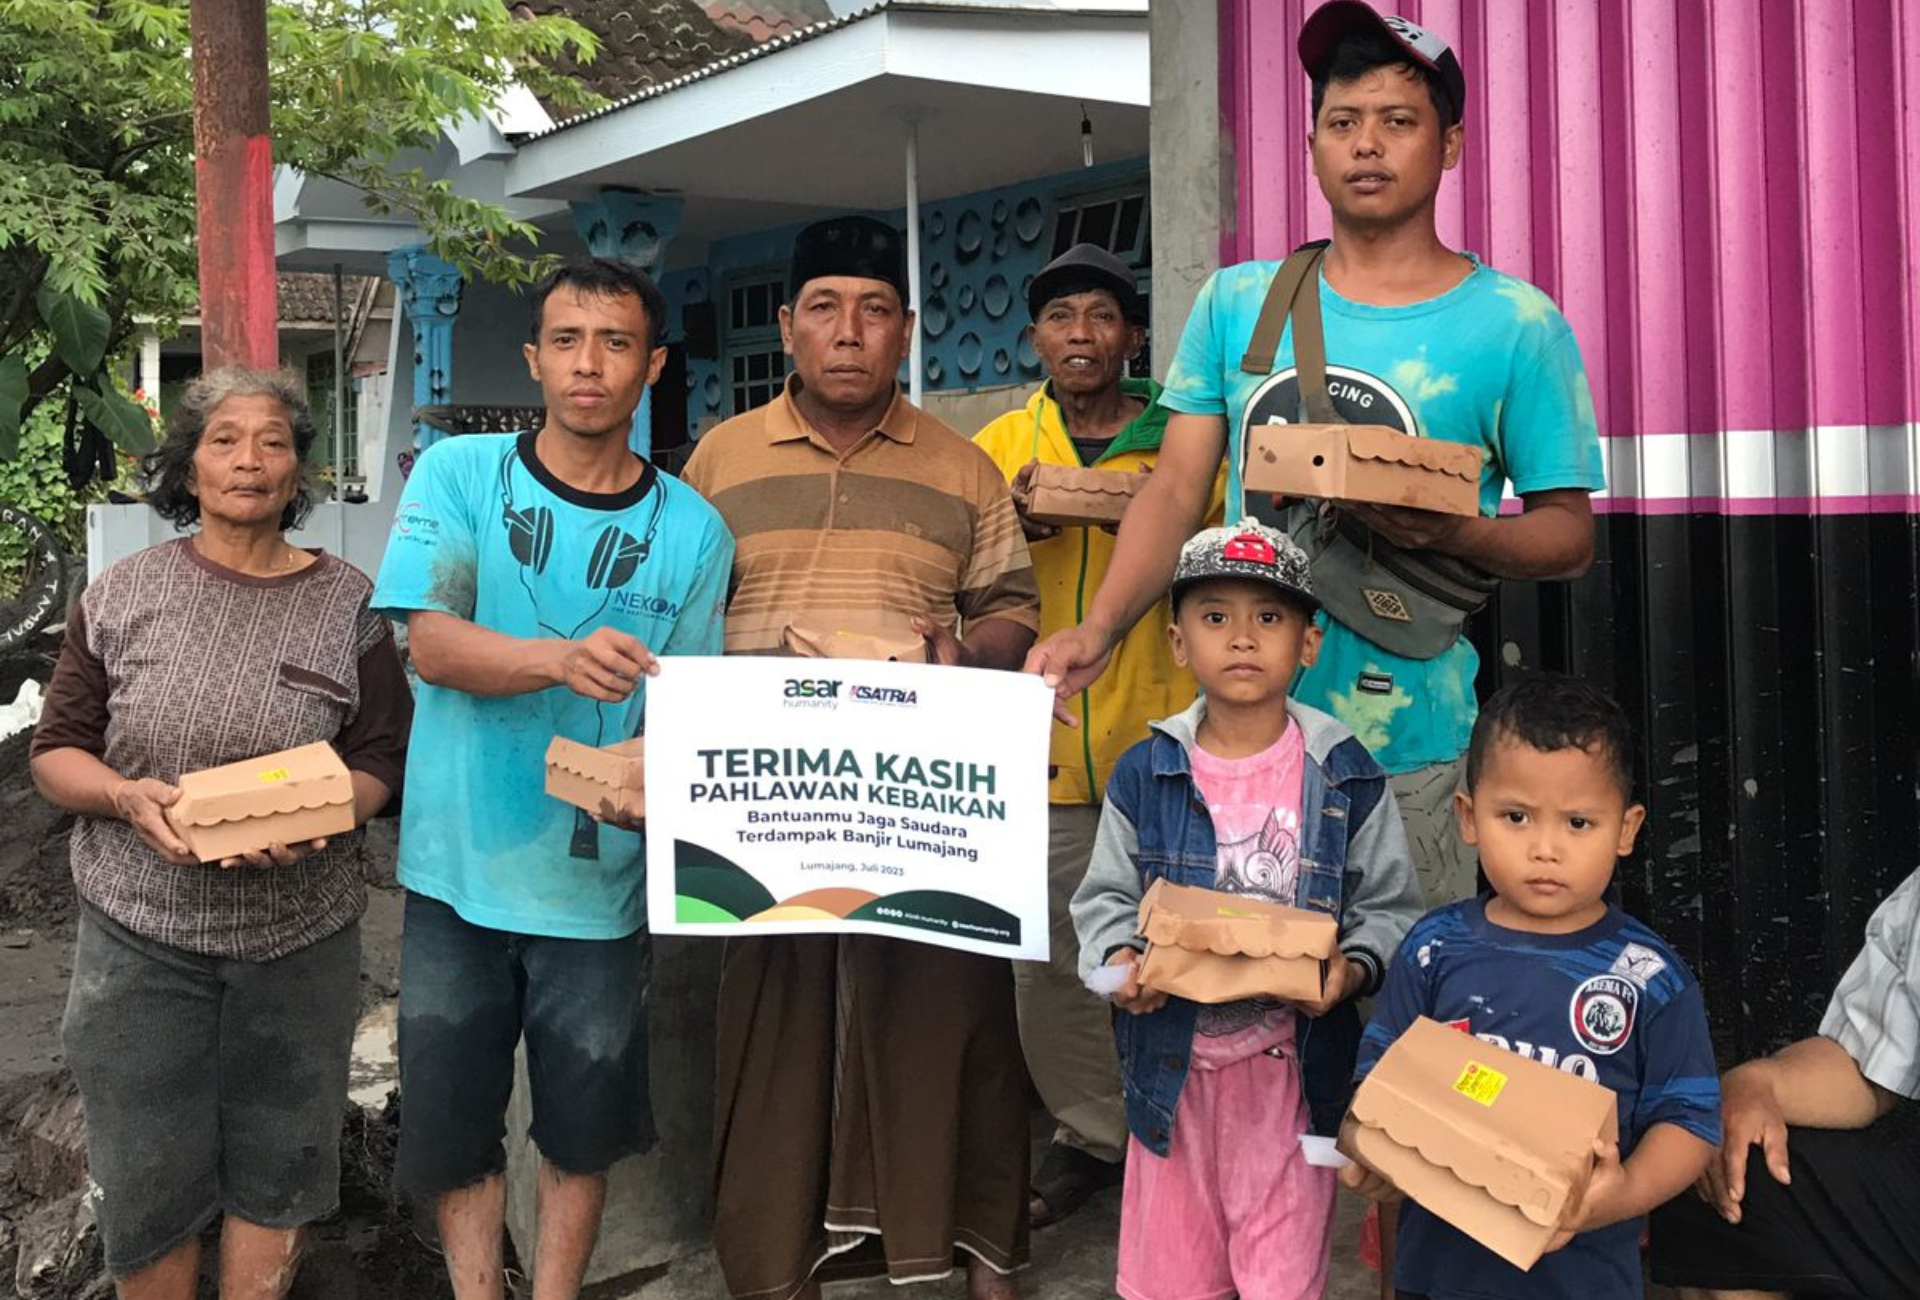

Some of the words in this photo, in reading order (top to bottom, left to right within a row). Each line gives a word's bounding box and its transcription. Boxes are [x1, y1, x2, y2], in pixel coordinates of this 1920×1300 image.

[1328, 381, 1374, 409] CING
[1373, 594, 1402, 616] EIGER
[783, 678, 843, 699] asar
[783, 699, 839, 711] humanity
[697, 748, 863, 778] TERIMA
[875, 752, 996, 795] KASIH
[690, 781, 858, 803] PAHLAWAN
[868, 784, 1006, 821] KEBAIKAN
[747, 810, 853, 823] Bantuanmu
[857, 811, 896, 829] Jaga
[900, 816, 968, 839] Saudara
[736, 828, 838, 844] Terdampak
[843, 830, 892, 848] Banjir
[897, 835, 978, 862] Lumajang
[800, 861, 858, 872] Lumajang,
[860, 863, 879, 872] Juli
[1586, 979, 1620, 996] AREMA
[1622, 985, 1634, 1004] FC
